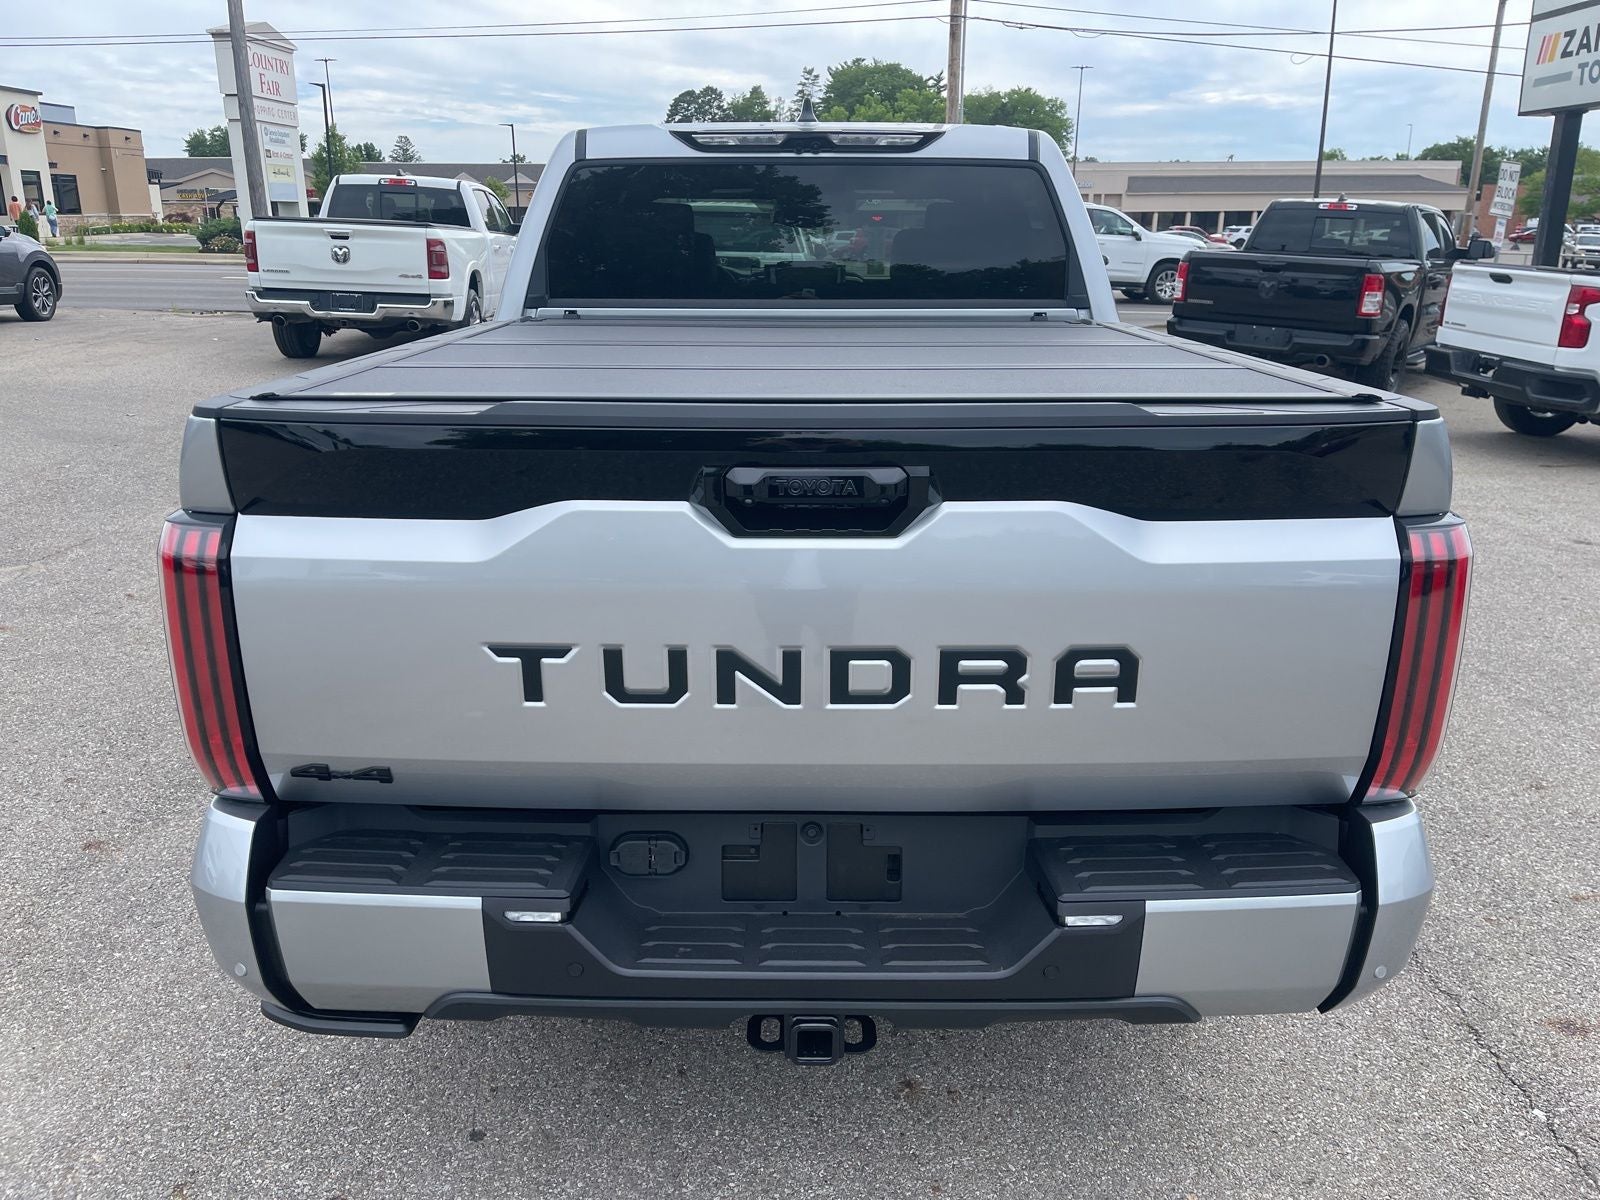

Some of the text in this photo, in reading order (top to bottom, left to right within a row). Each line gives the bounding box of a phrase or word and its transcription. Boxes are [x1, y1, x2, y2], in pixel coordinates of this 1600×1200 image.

[258, 73, 282, 97] FAIR
[254, 104, 297, 121] OPPING CENTER
[1500, 168, 1520, 182] DO NOT
[1496, 186, 1516, 200] BLOCK
[775, 479, 858, 496] TOYOTA
[482, 642, 1142, 710] TUNDRA
